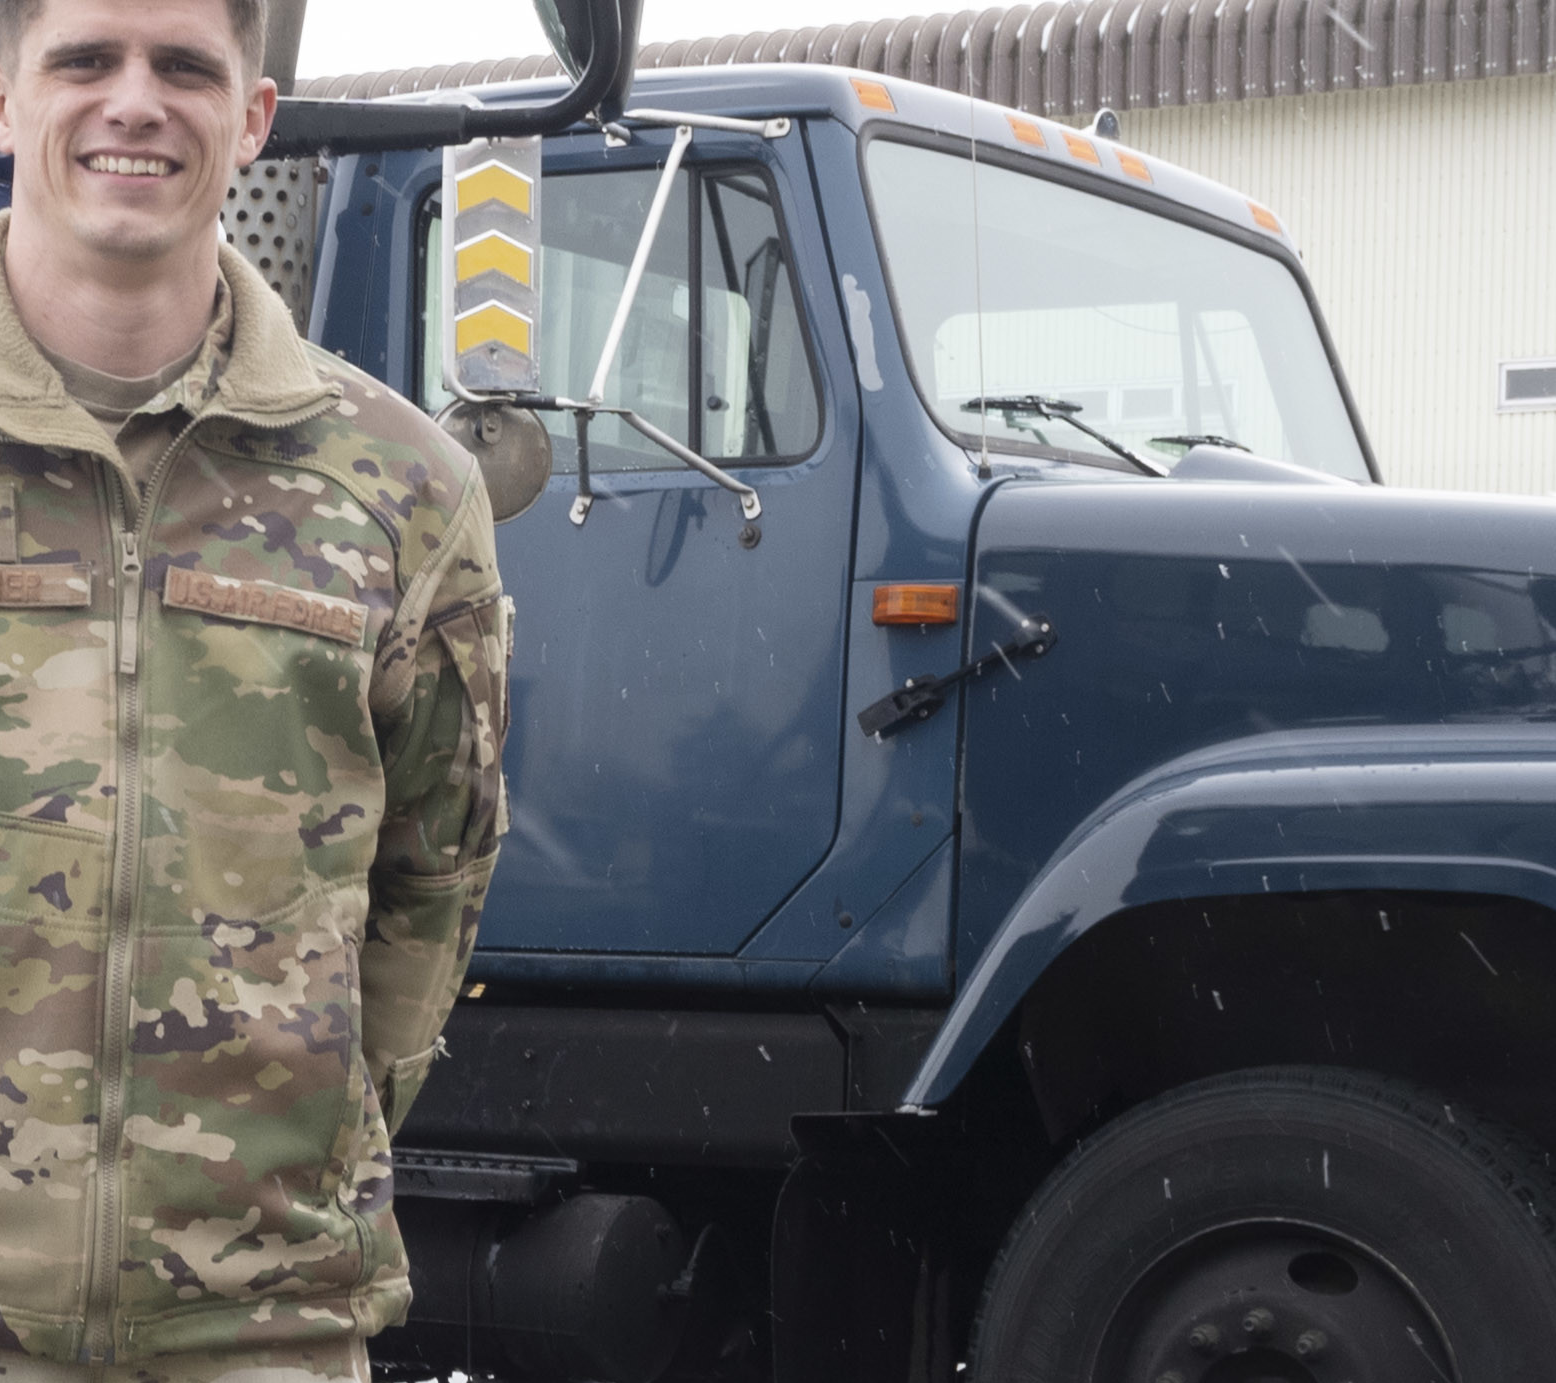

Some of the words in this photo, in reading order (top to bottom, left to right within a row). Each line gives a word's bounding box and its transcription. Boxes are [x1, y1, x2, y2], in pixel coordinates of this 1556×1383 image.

[170, 573, 218, 611] U.S.
[222, 583, 267, 617] AIR
[273, 590, 362, 641] FORCE
